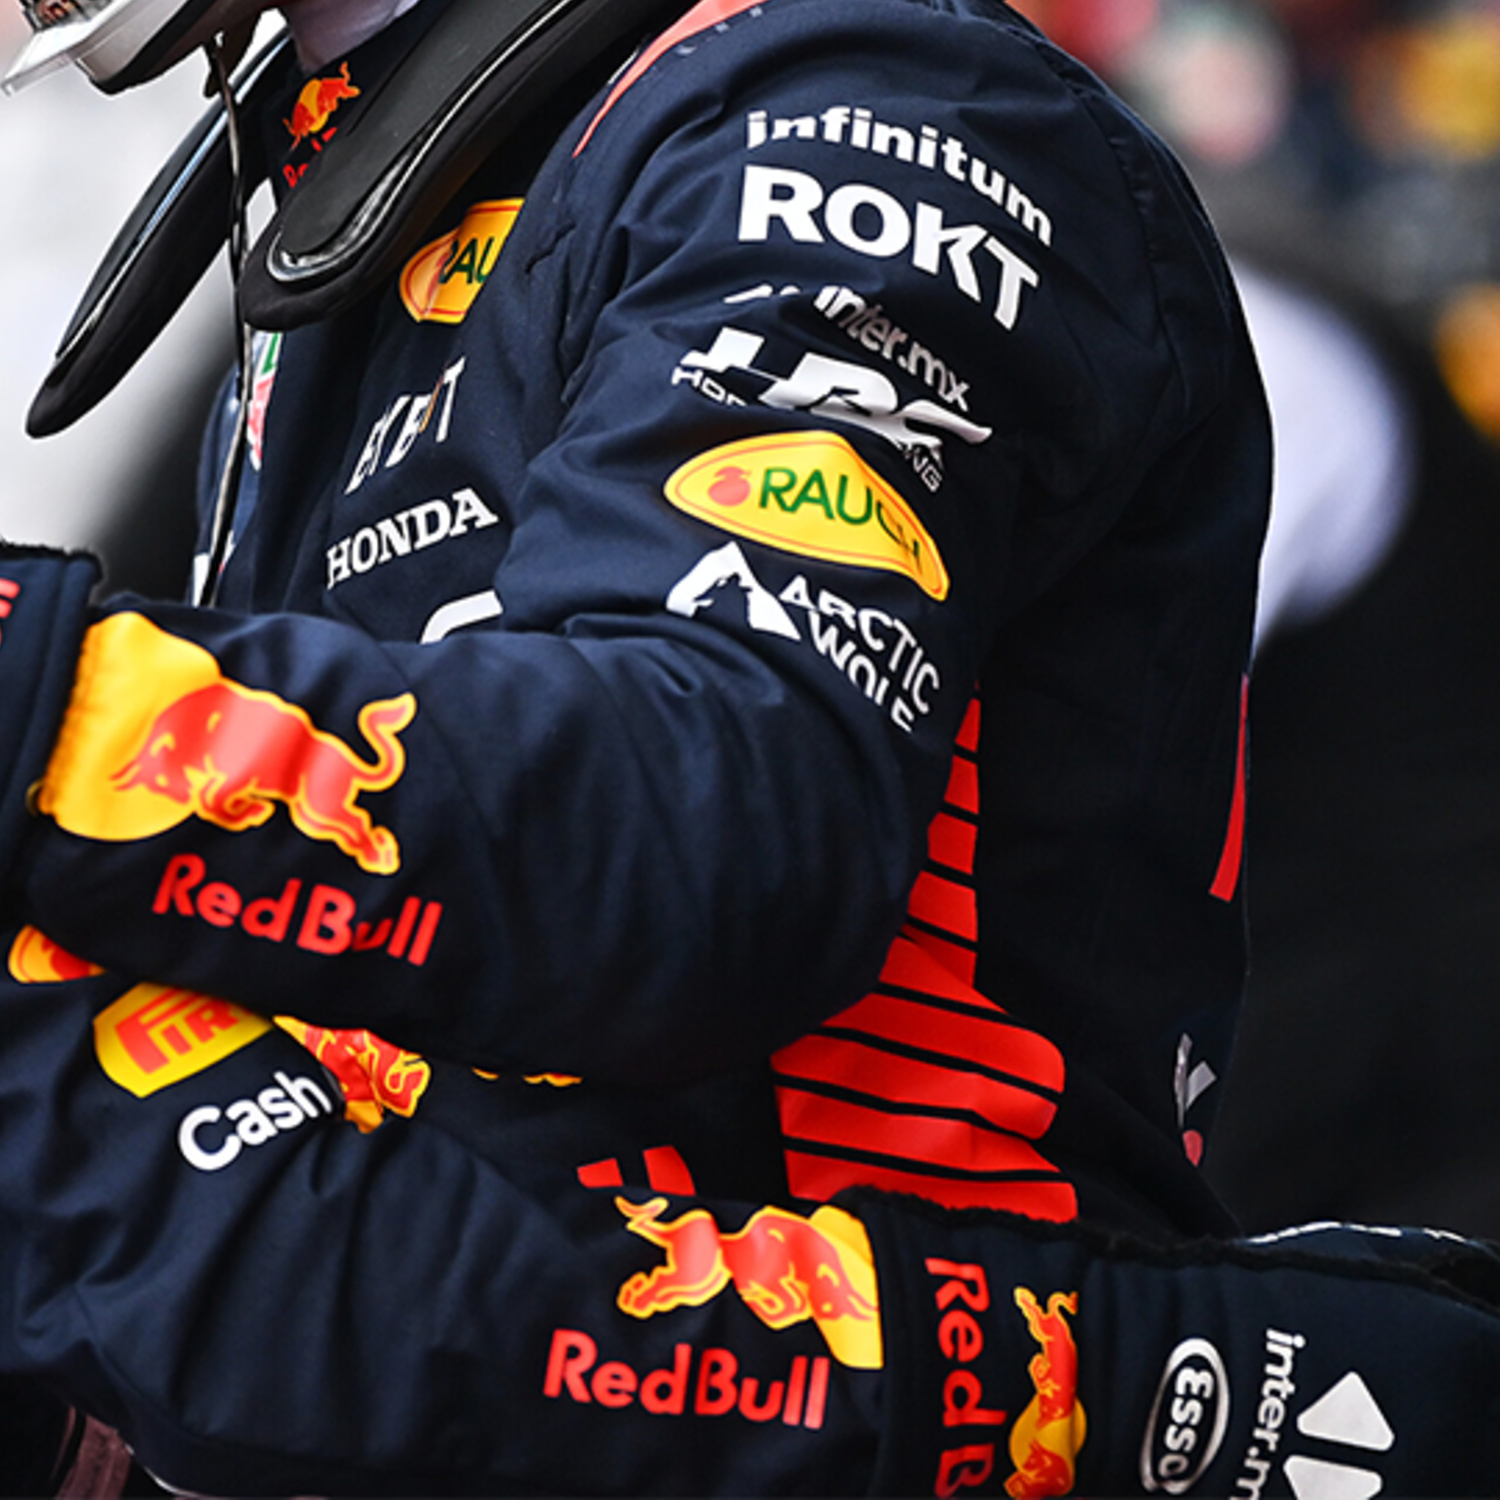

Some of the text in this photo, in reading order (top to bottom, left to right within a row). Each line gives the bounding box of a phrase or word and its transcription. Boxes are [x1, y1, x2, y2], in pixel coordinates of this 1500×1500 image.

[747, 105, 1053, 247] infinitum
[737, 164, 1039, 331] ROKT
[814, 285, 972, 411] inter.mx
[327, 488, 499, 589] HONDA
[781, 574, 940, 715] ARCTIC
[153, 853, 443, 966] Red Bull
[178, 1070, 332, 1171] Cash
[544, 1328, 828, 1431] Red Bull
[925, 1257, 1007, 1427] Red
[1230, 1327, 1306, 1500] inter.m
